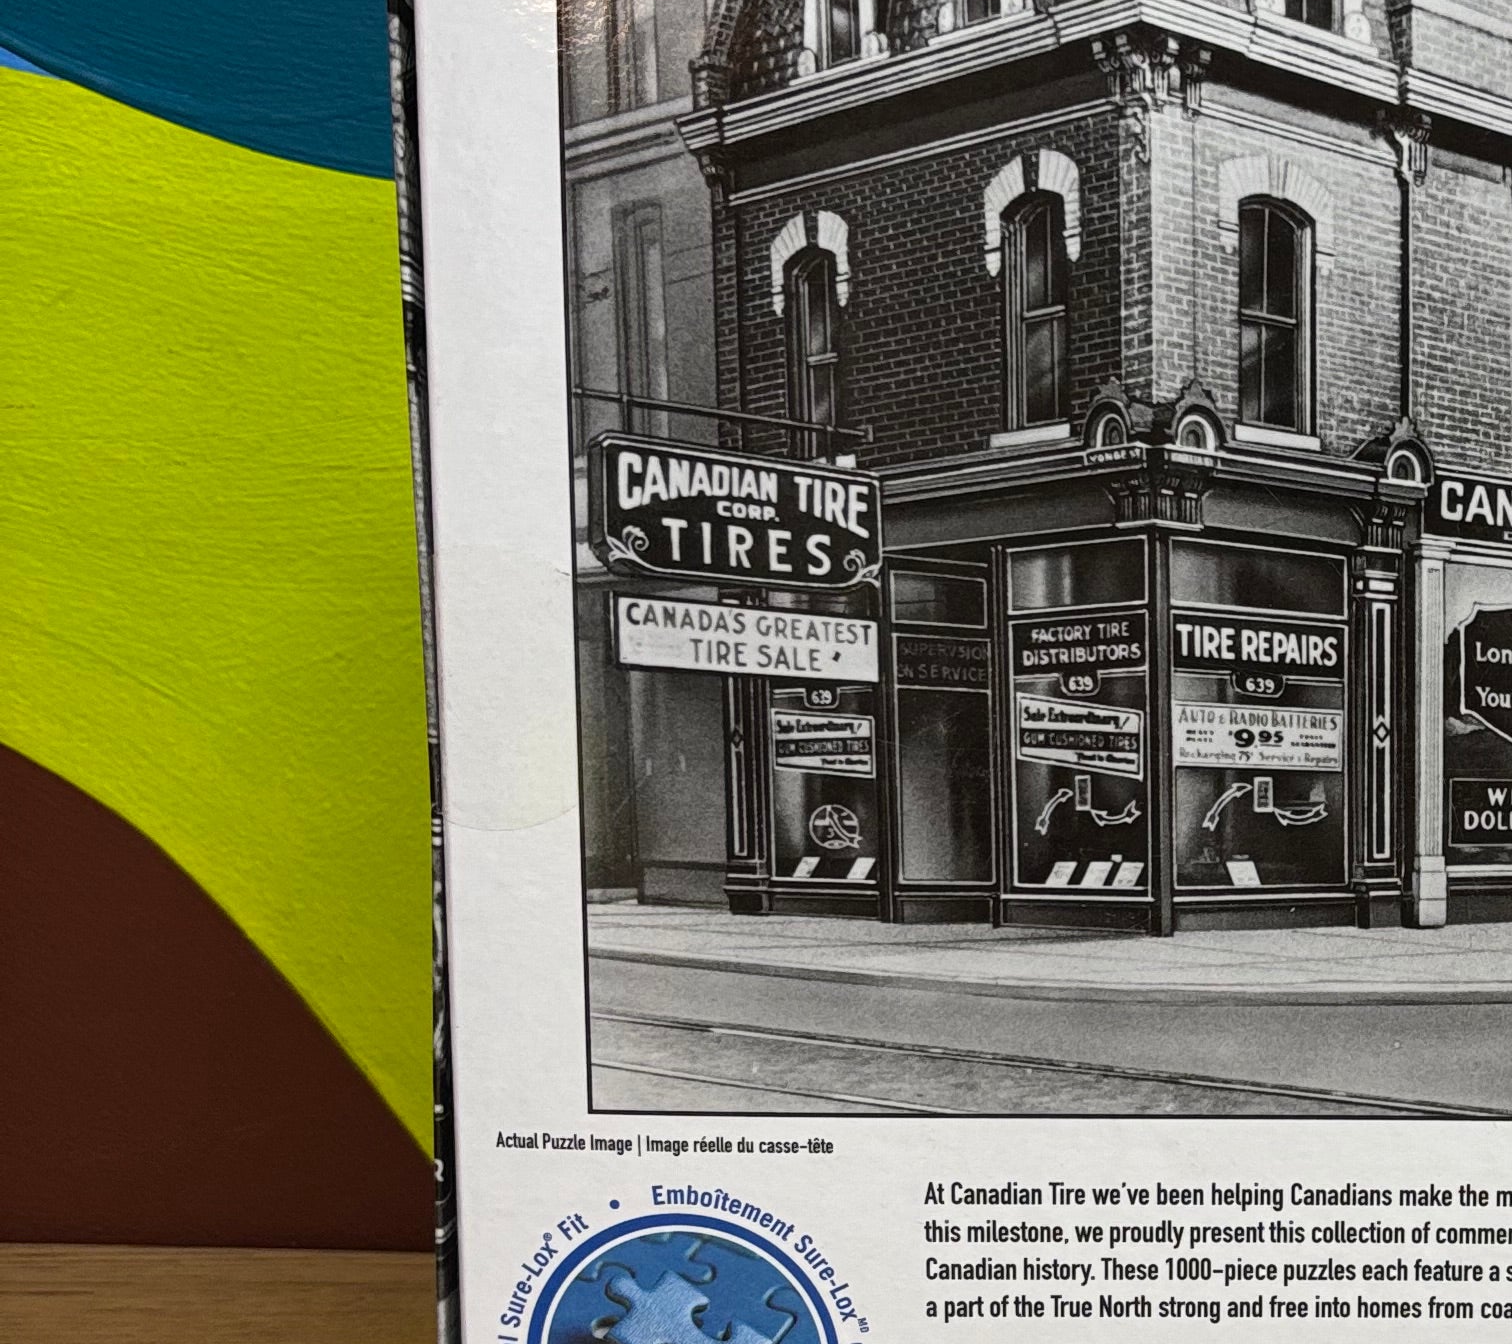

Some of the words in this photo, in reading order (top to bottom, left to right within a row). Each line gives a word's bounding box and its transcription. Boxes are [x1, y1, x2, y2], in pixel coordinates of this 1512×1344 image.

[617, 451, 778, 510] CANADIAN
[794, 477, 870, 539] TIRE
[717, 501, 780, 522] CORP.
[662, 518, 832, 576] TIRES
[626, 602, 746, 634] CANADA'S
[756, 617, 872, 645] GREATEST
[1031, 625, 1092, 643] FACTORY
[1098, 622, 1130, 639] TIRE
[690, 638, 747, 667] TIRE
[757, 645, 823, 672] SALE
[1022, 643, 1141, 666] DISTRIBUTORS
[1176, 624, 1236, 660] TIRE
[1241, 629, 1338, 667] REPAIRS
[811, 690, 832, 704] 639
[1069, 676, 1093, 691] 639
[1245, 678, 1275, 693] 639
[1229, 709, 1268, 727] RADIO
[496, 1131, 538, 1150] Actual
[543, 1134, 586, 1151] Puzzle
[590, 1134, 633, 1153] Image
[646, 1136, 689, 1154] Image
[693, 1136, 733, 1153] réelle
[737, 1137, 754, 1153] du
[759, 1137, 834, 1154] casse-tête
[924, 1182, 944, 1204] At
[951, 1182, 1042, 1205] Canadian
[1049, 1182, 1085, 1205] Tire
[1092, 1182, 1149, 1205] we've
[1157, 1183, 1203, 1205] been
[1212, 1183, 1283, 1211] helping
[1291, 1183, 1392, 1206] Canadians
[1400, 1184, 1452, 1206] make
[1459, 1184, 1488, 1206] the
[558, 1213, 590, 1241] Fit
[651, 1185, 795, 1242] Emboîtement
[927, 1301, 937, 1317] a
[945, 1296, 984, 1323] part
[990, 1295, 1009, 1317] of
[1014, 1295, 1044, 1317] the
[1051, 1295, 1092, 1317] True
[1100, 1295, 1151, 1317] North
[1159, 1297, 1220, 1323] strong
[1228, 1295, 1262, 1317] and
[1269, 1296, 1308, 1317] free
[1316, 1296, 1350, 1317] into
[1358, 1296, 1421, 1318] homes
[1428, 1296, 1473, 1318] from
